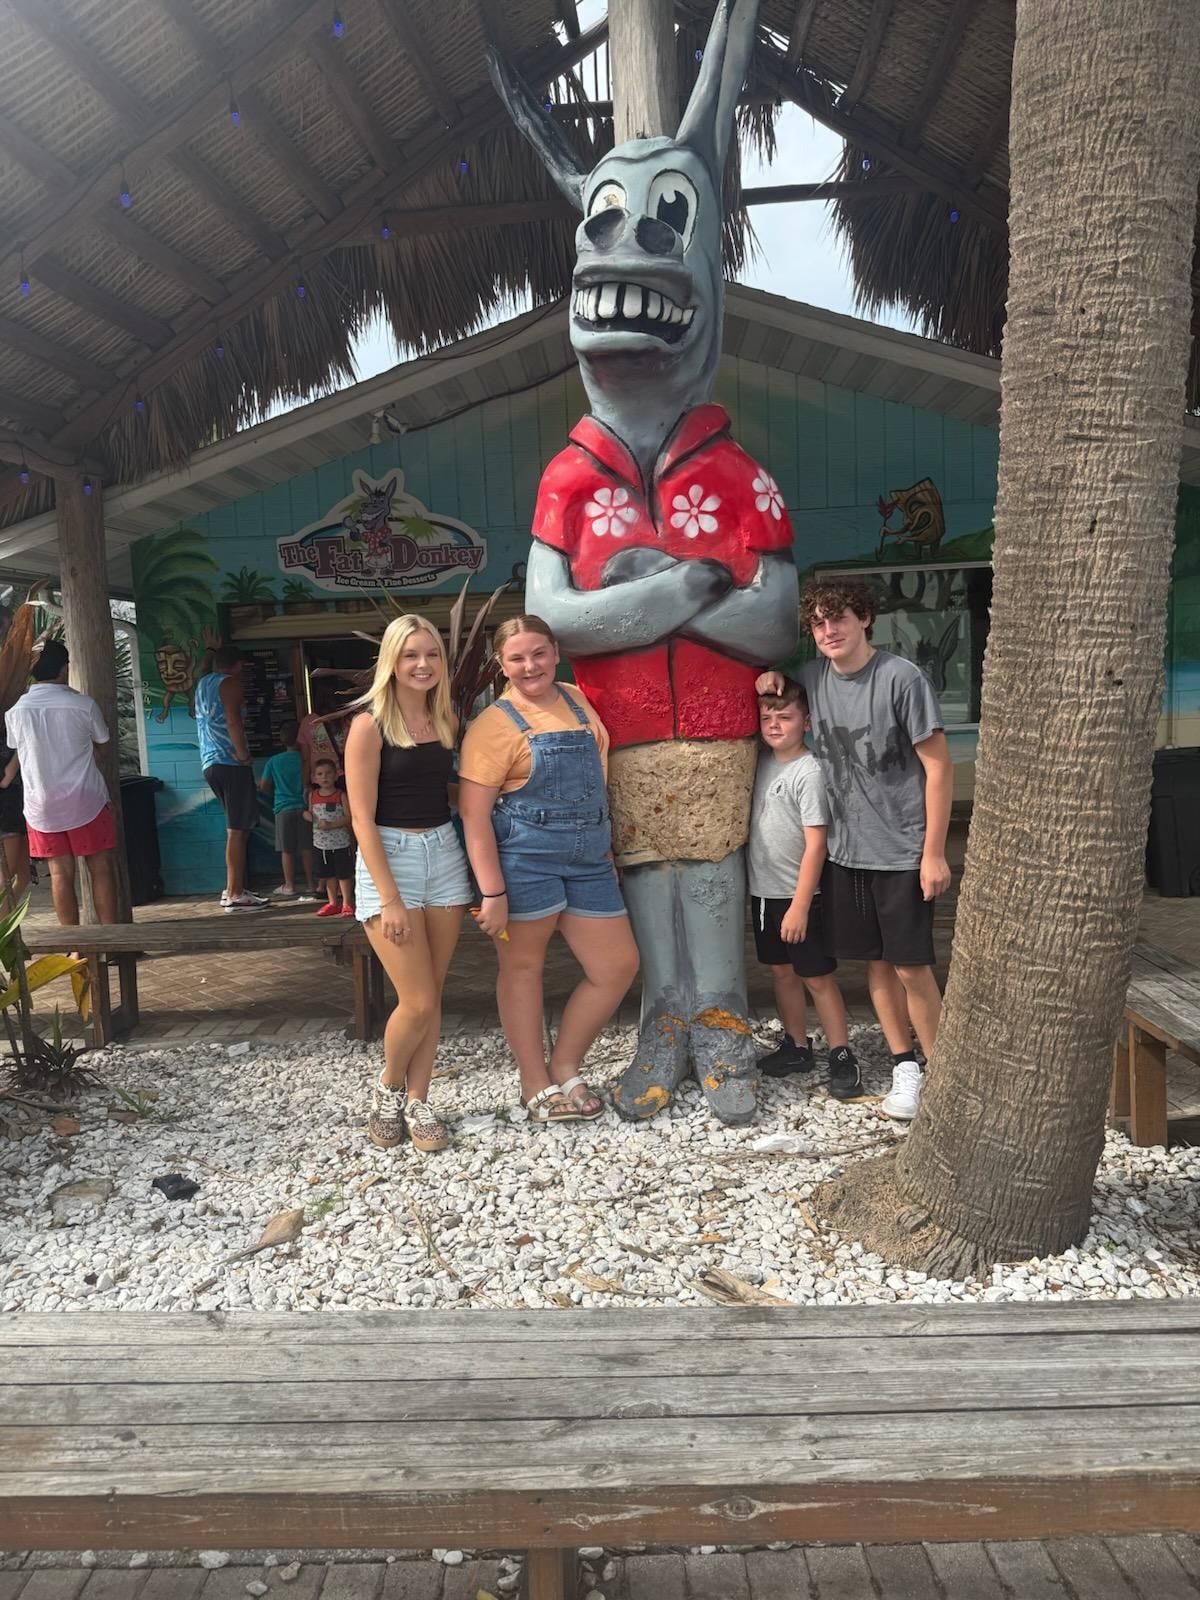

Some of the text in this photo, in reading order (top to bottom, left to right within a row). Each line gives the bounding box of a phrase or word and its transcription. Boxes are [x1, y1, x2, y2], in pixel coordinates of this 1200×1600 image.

[280, 536, 483, 577] The Fat Donkey
[336, 576, 349, 585] Ice
[350, 578, 375, 587] Cream
[384, 579, 402, 587] Fine
[402, 574, 436, 586] Desserts
